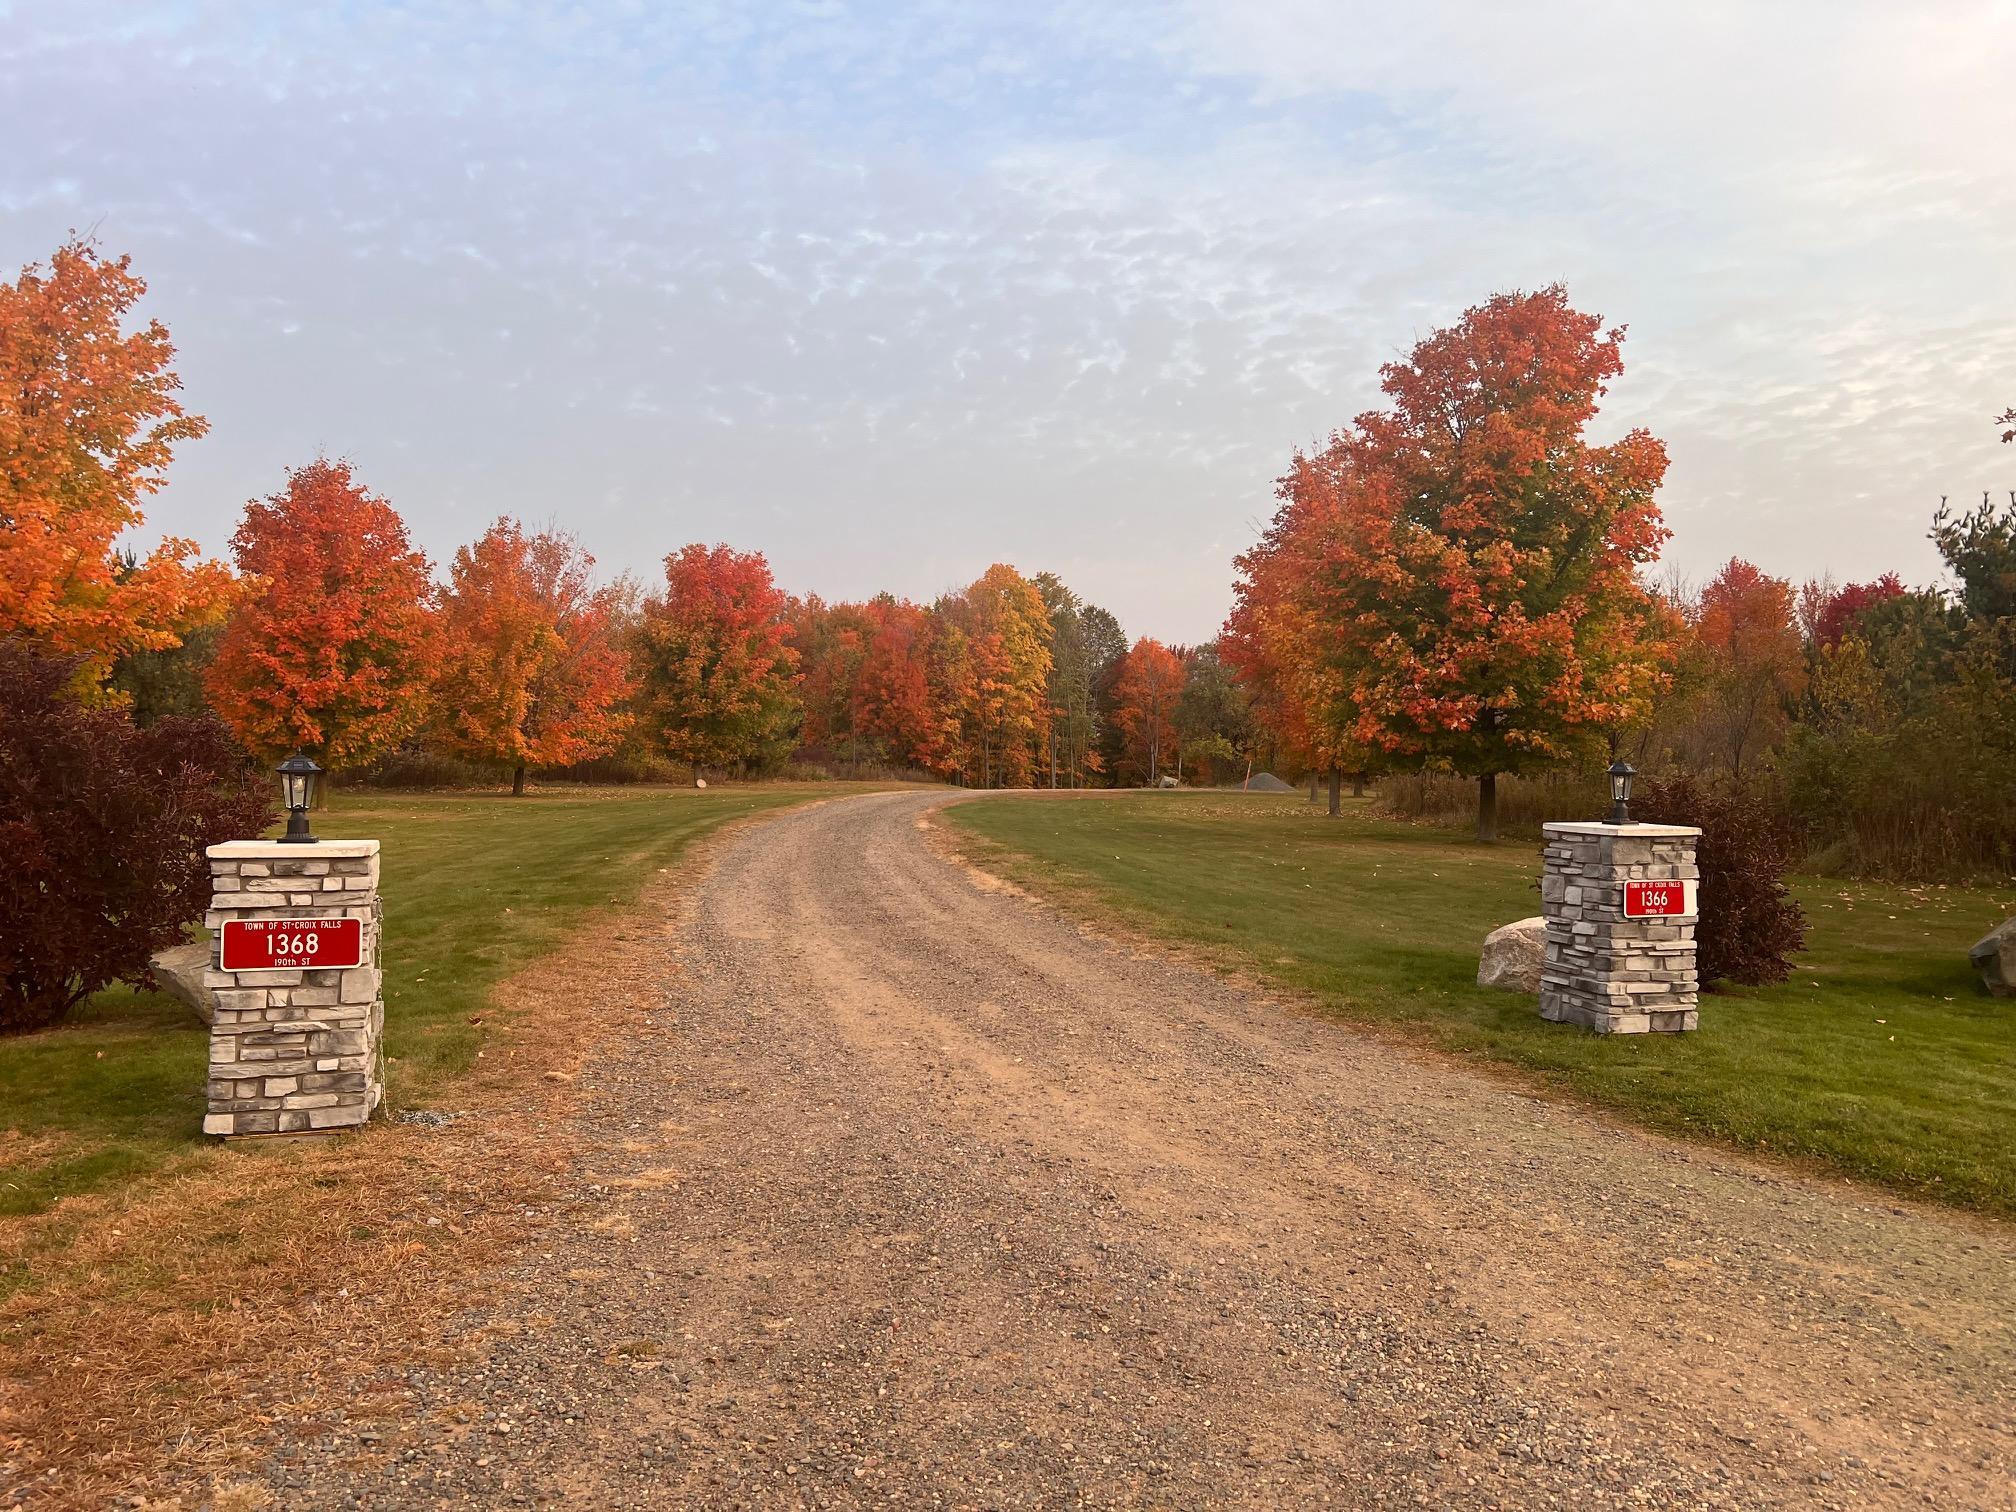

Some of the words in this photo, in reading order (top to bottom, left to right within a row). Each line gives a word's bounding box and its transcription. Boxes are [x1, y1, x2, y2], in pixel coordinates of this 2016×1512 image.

[1642, 891, 1668, 906] 1366
[244, 922, 263, 930] TOWN
[269, 922, 278, 930] OF
[321, 921, 341, 929] FALLS
[267, 933, 319, 955] 1368
[275, 958, 296, 966] 190th
